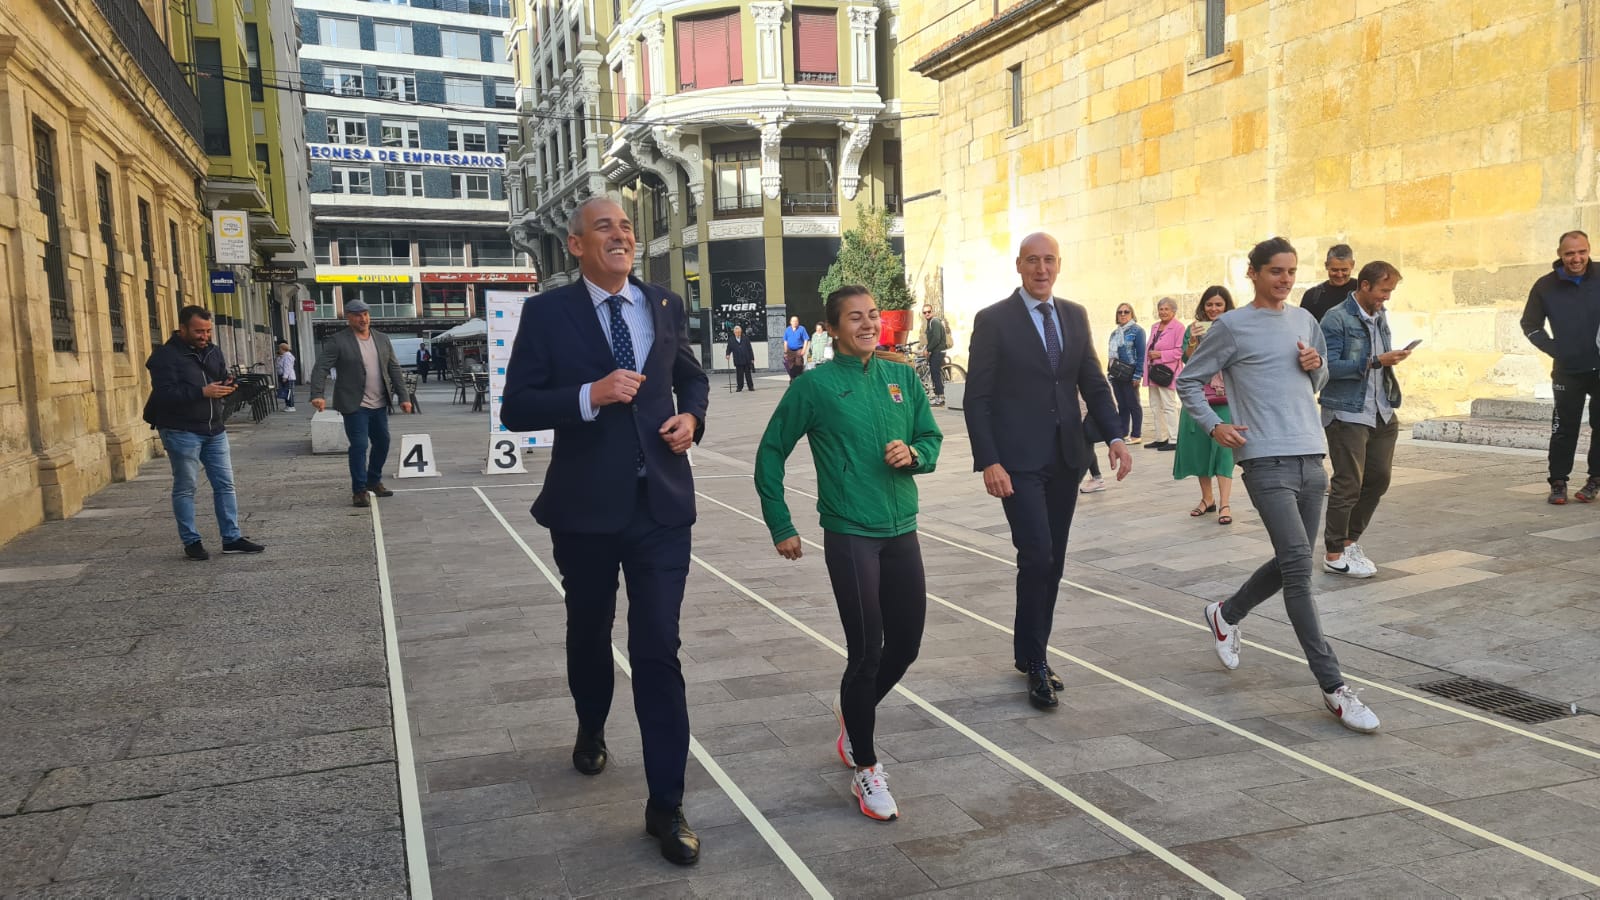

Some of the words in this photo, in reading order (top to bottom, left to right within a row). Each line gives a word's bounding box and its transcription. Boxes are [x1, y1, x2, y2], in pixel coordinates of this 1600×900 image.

[379, 150, 398, 161] DE
[403, 152, 504, 167] EMPRESARIOS
[721, 303, 757, 311] TIGER
[403, 444, 428, 472] 4
[494, 440, 517, 468] 3
